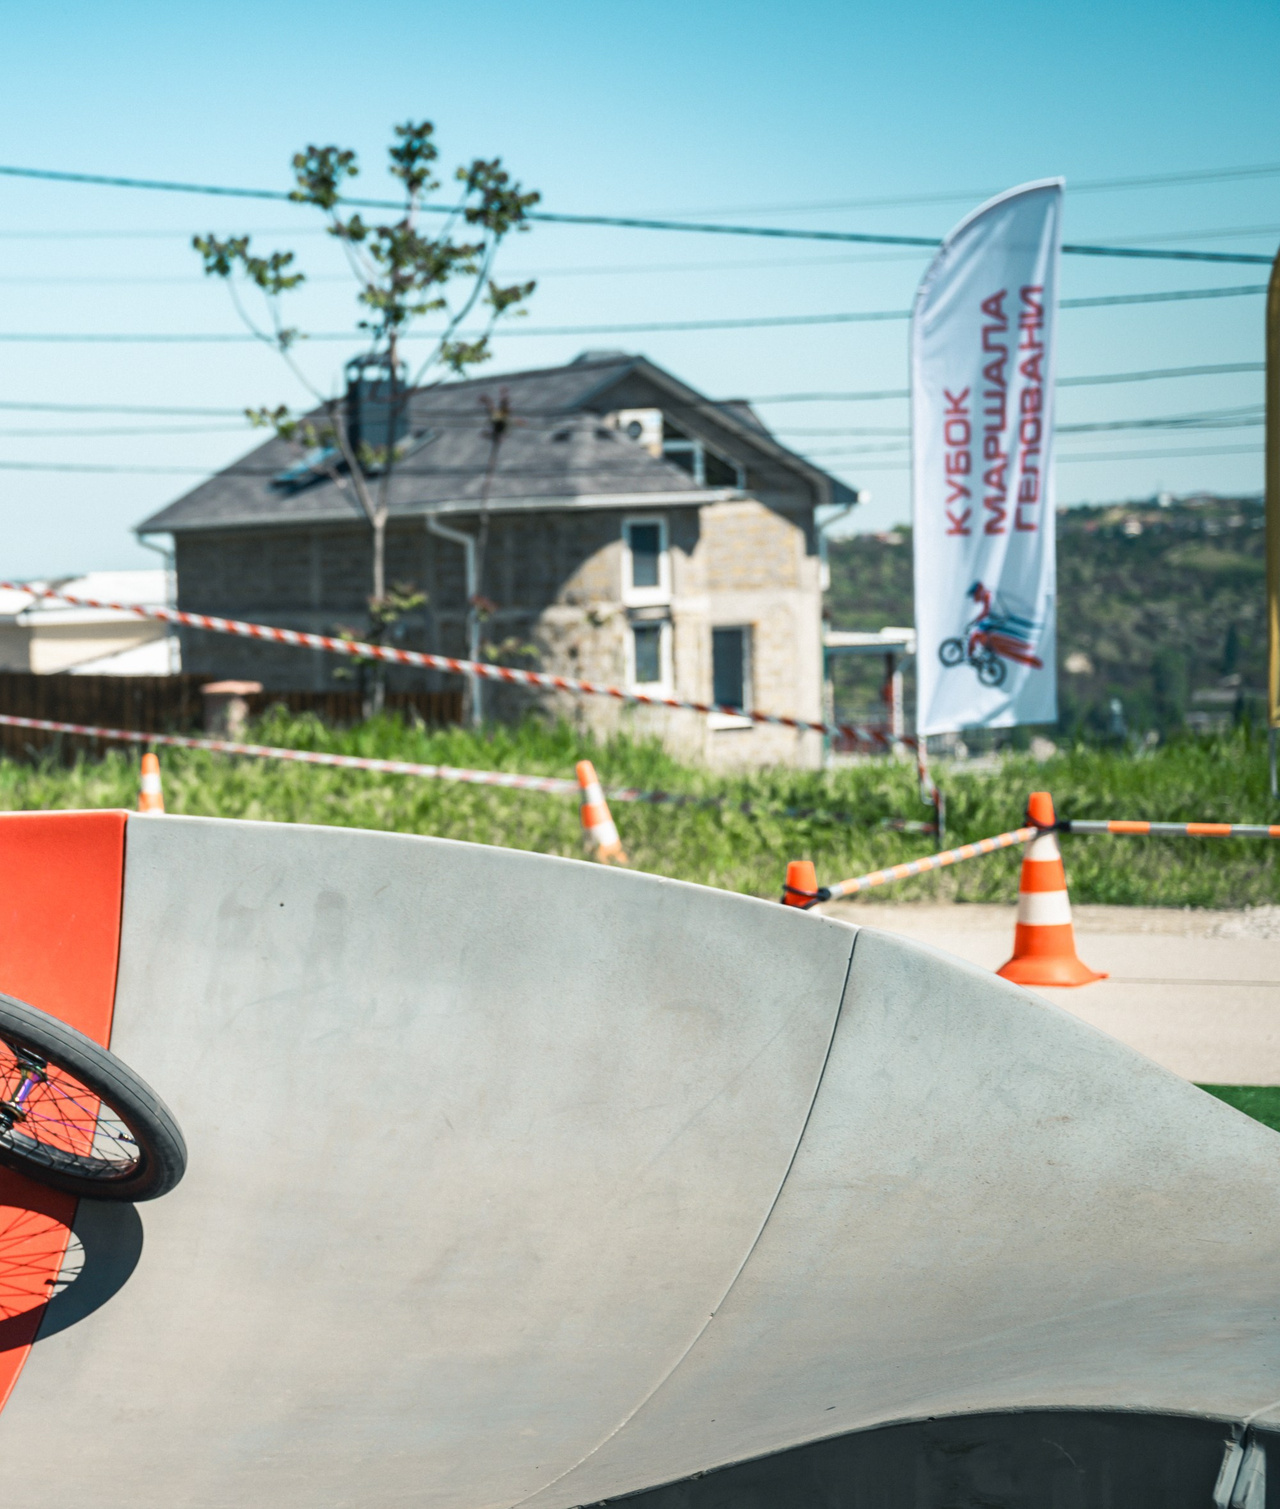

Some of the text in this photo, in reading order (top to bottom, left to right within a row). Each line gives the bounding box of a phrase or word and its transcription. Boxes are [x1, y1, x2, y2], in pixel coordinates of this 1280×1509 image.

[944, 385, 971, 537] КУБОК
[981, 288, 1009, 536] МАРШАЛА
[1015, 284, 1045, 533] ГЕЛОВАНИ
